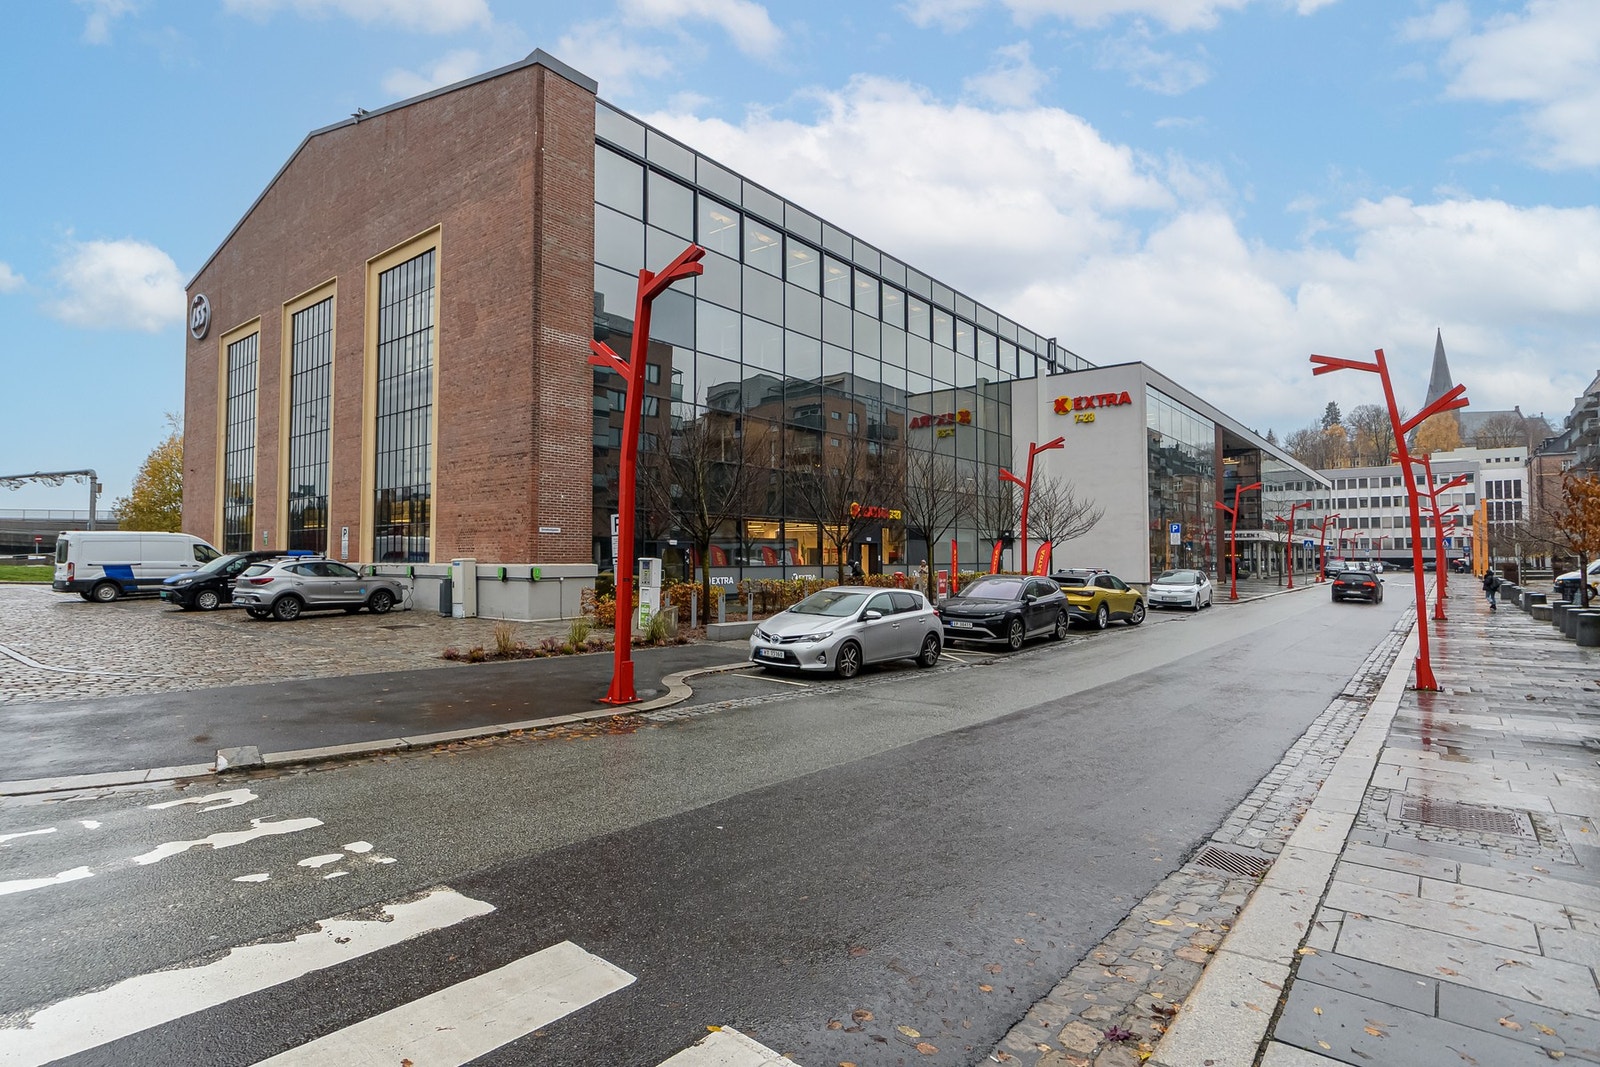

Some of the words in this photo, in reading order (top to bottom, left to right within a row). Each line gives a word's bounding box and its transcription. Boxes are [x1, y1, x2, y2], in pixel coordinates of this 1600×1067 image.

[1073, 391, 1132, 411] EXTRA
[1075, 413, 1095, 424] 7-23
[711, 577, 734, 585] EXTRA
